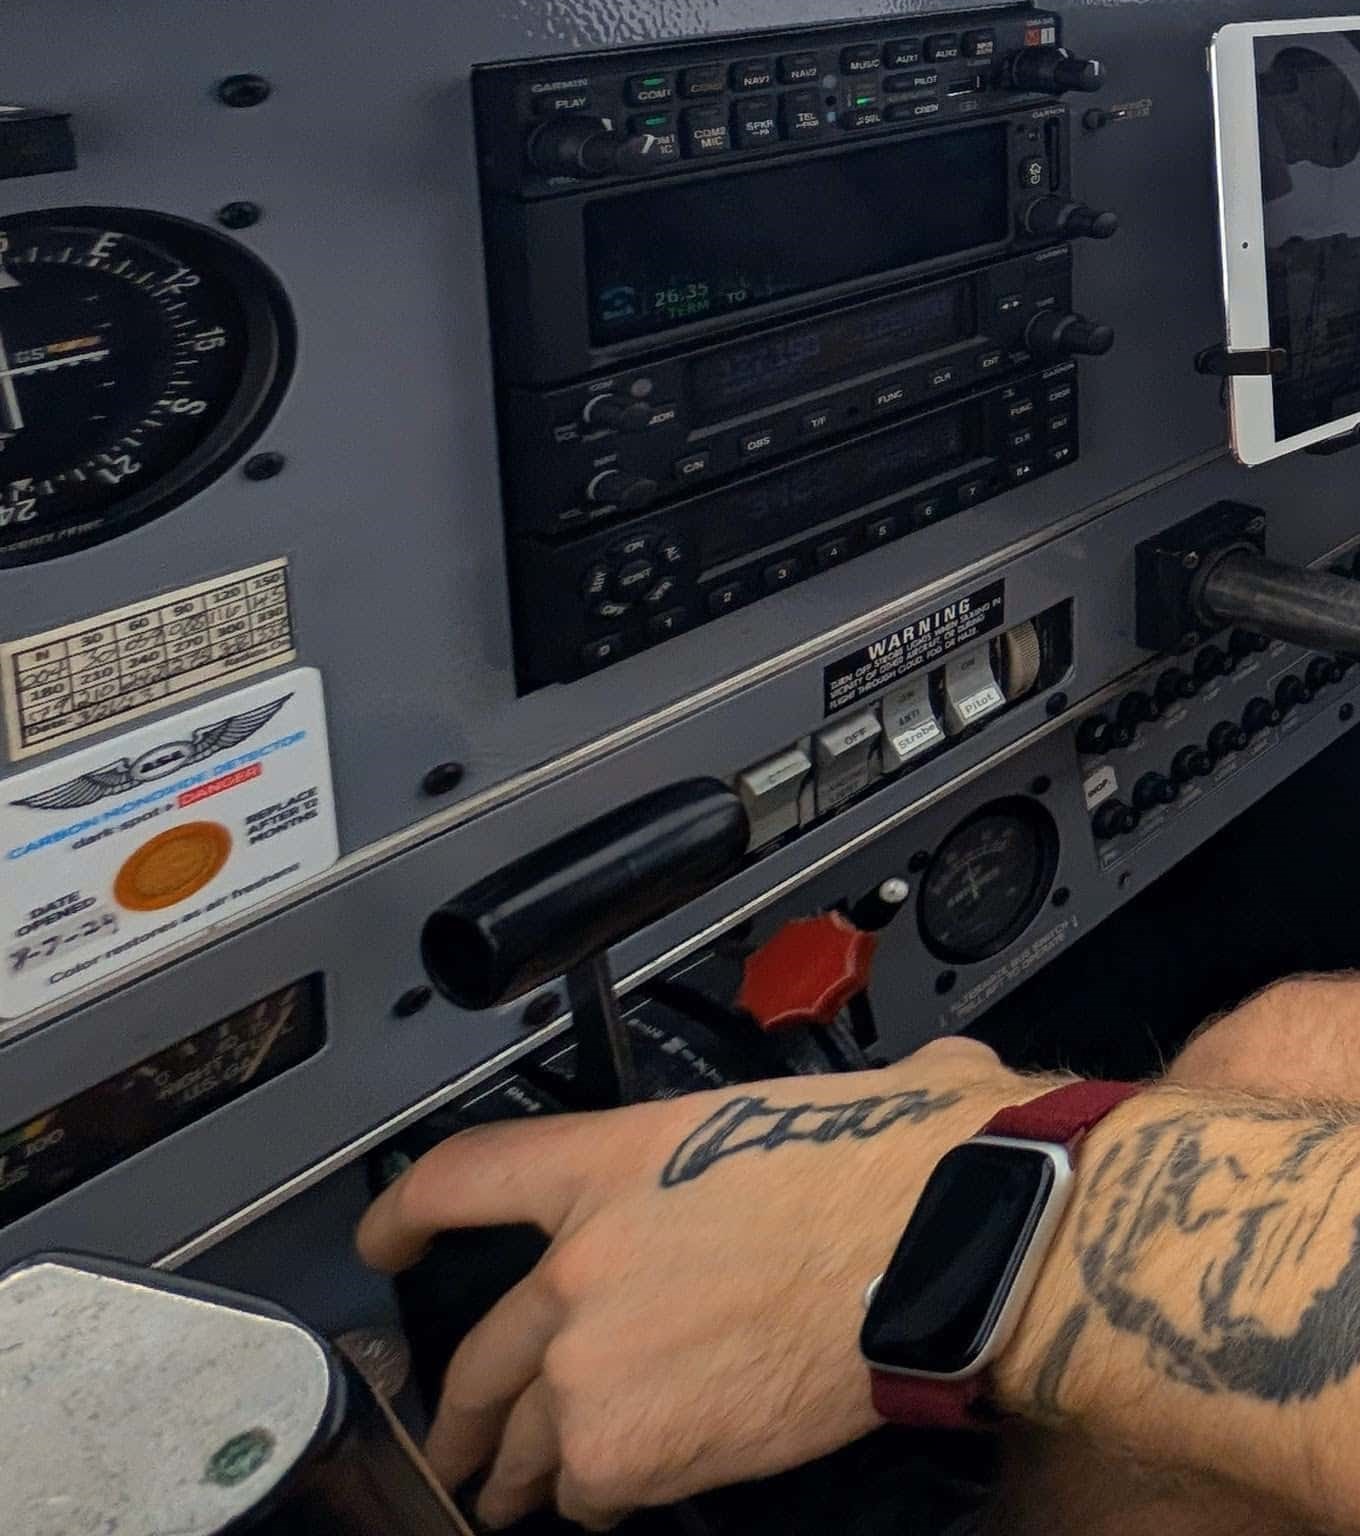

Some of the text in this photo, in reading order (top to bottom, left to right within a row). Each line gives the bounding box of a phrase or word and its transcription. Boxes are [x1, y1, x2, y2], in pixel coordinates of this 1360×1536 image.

[849, 49, 958, 70] MUSIC AUX1 AUX2
[531, 77, 589, 93] GARMIN
[554, 74, 938, 110] PLAY PILOT
[700, 135, 724, 149] MIC
[91, 231, 122, 258] E
[170, 397, 208, 415] S
[876, 389, 905, 405] FUNC
[80, 632, 104, 648] 30
[128, 616, 150, 632] 60
[173, 601, 195, 617] 90
[212, 586, 243, 604] 120
[254, 571, 282, 591] 150
[867, 597, 971, 661] WARNING
[29, 682, 66, 703] 180
[81, 666, 115, 686] 210
[126, 649, 161, 669] 240
[173, 634, 204, 654] 270
[217, 620, 246, 638] 300
[257, 605, 285, 624] 330
[858, 670, 898, 698] THROUGH
[964, 689, 996, 714] Pitot
[842, 725, 868, 747] OFF
[897, 721, 939, 751] Strobe
[139, 749, 185, 774] ASA
[5, 729, 307, 861] CARBON MONOXIDE DETECTOR
[71, 765, 260, 851] dark spot DANGER
[246, 786, 319, 825] REPLACE
[247, 798, 319, 836] AFTER 12
[249, 809, 319, 845] MONTHS
[15, 896, 97, 937] OPENED
[29, 890, 81, 920] DATE
[49, 954, 101, 985] Color
[104, 920, 178, 958] restores
